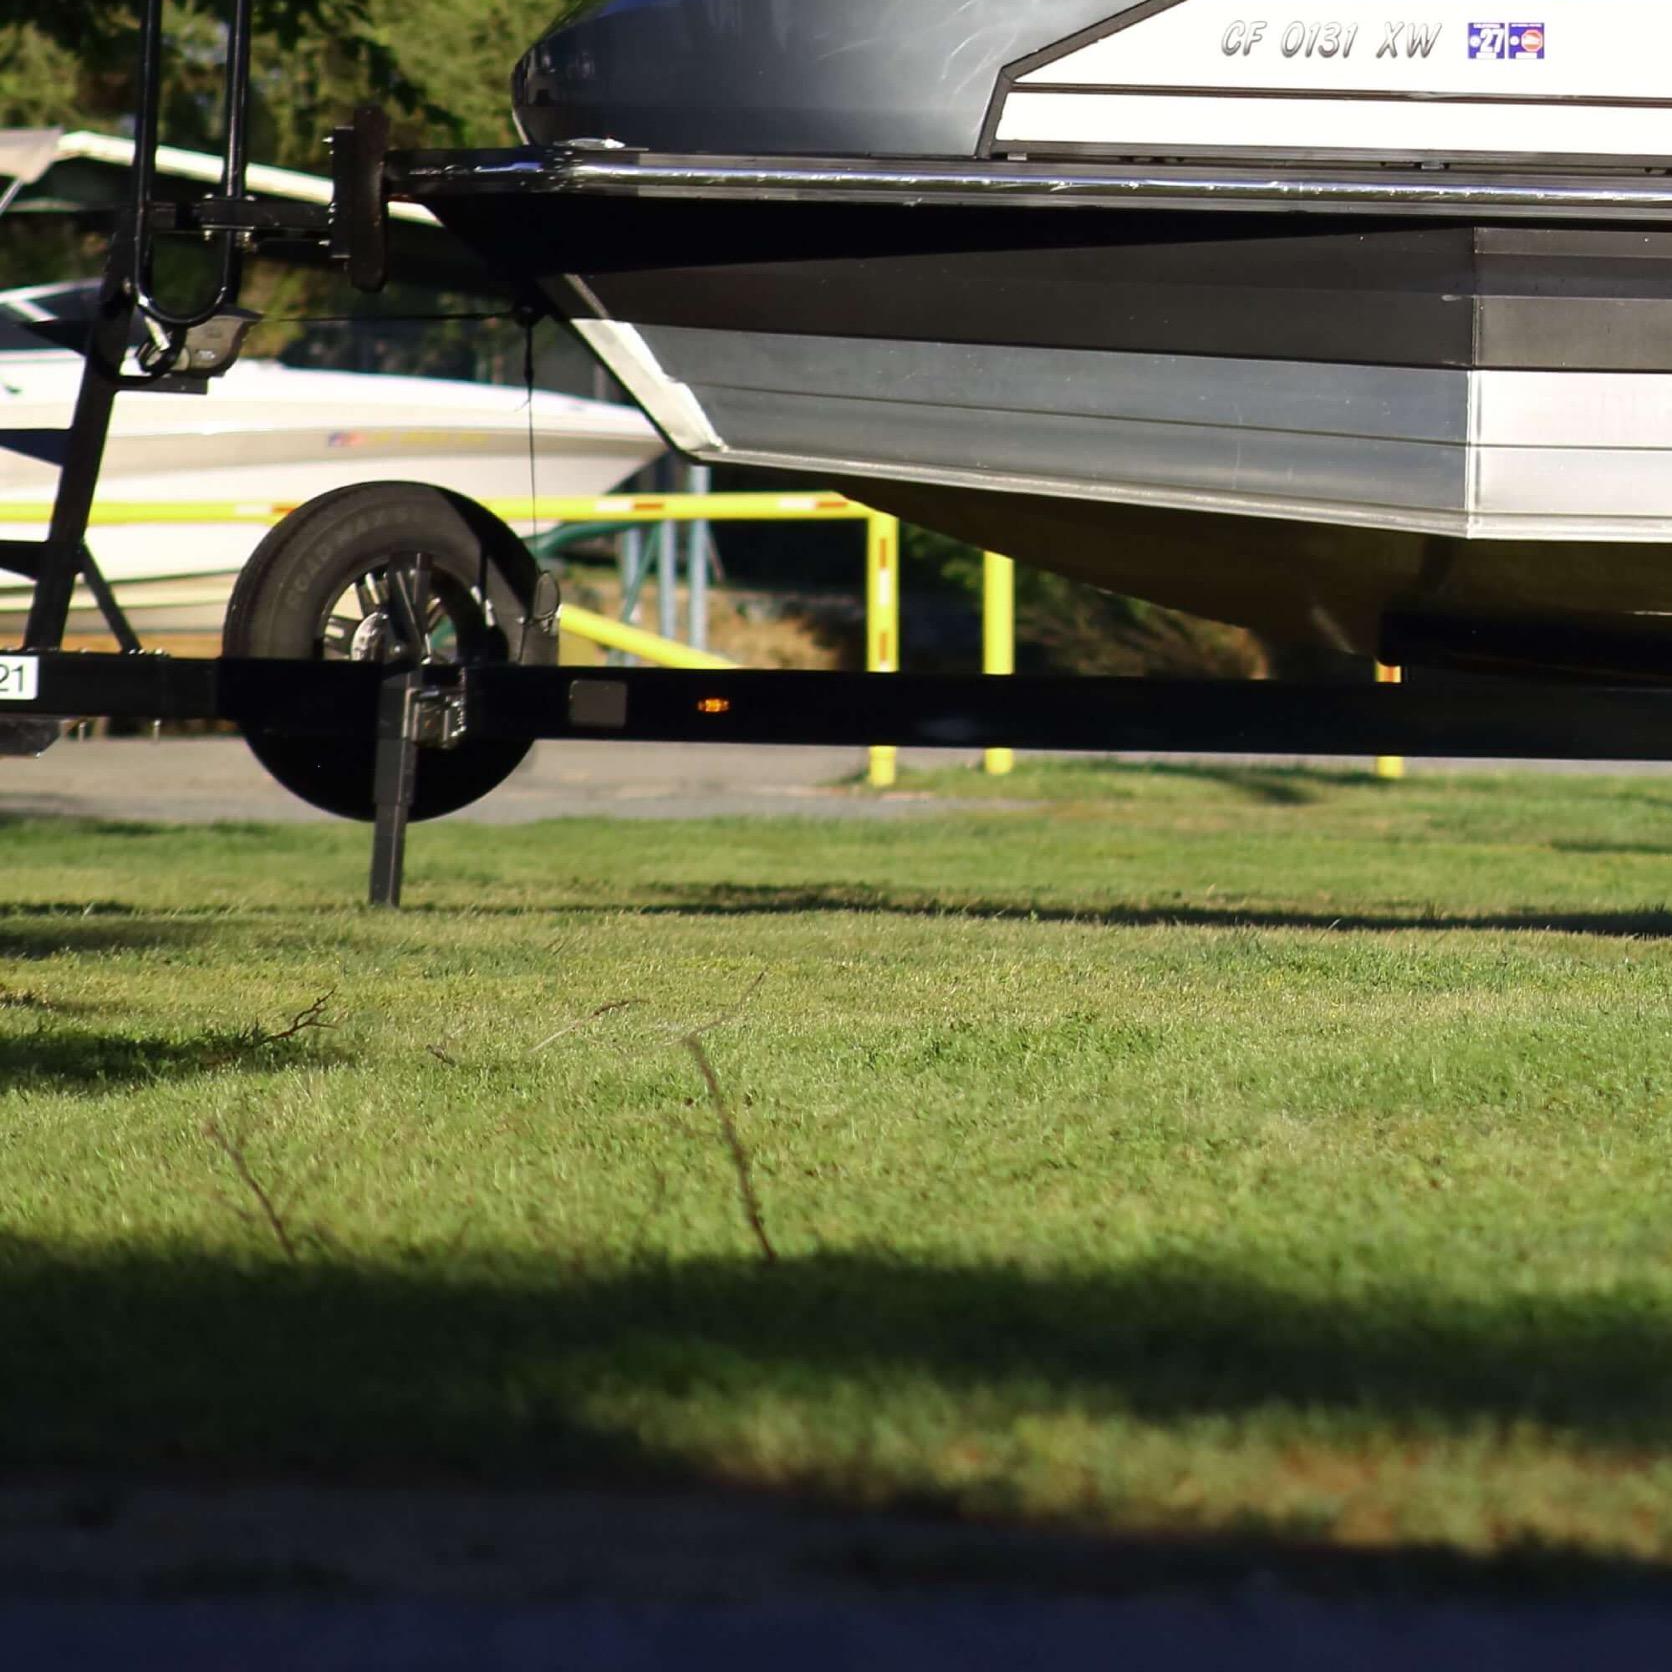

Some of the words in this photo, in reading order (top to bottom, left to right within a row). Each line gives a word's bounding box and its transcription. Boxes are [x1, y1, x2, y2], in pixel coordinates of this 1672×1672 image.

[1221, 20, 1268, 57] CF
[1280, 20, 1359, 58] 0131
[1375, 20, 1443, 59] XW
[1480, 27, 1504, 53] 27
[0, 664, 24, 693] 21
